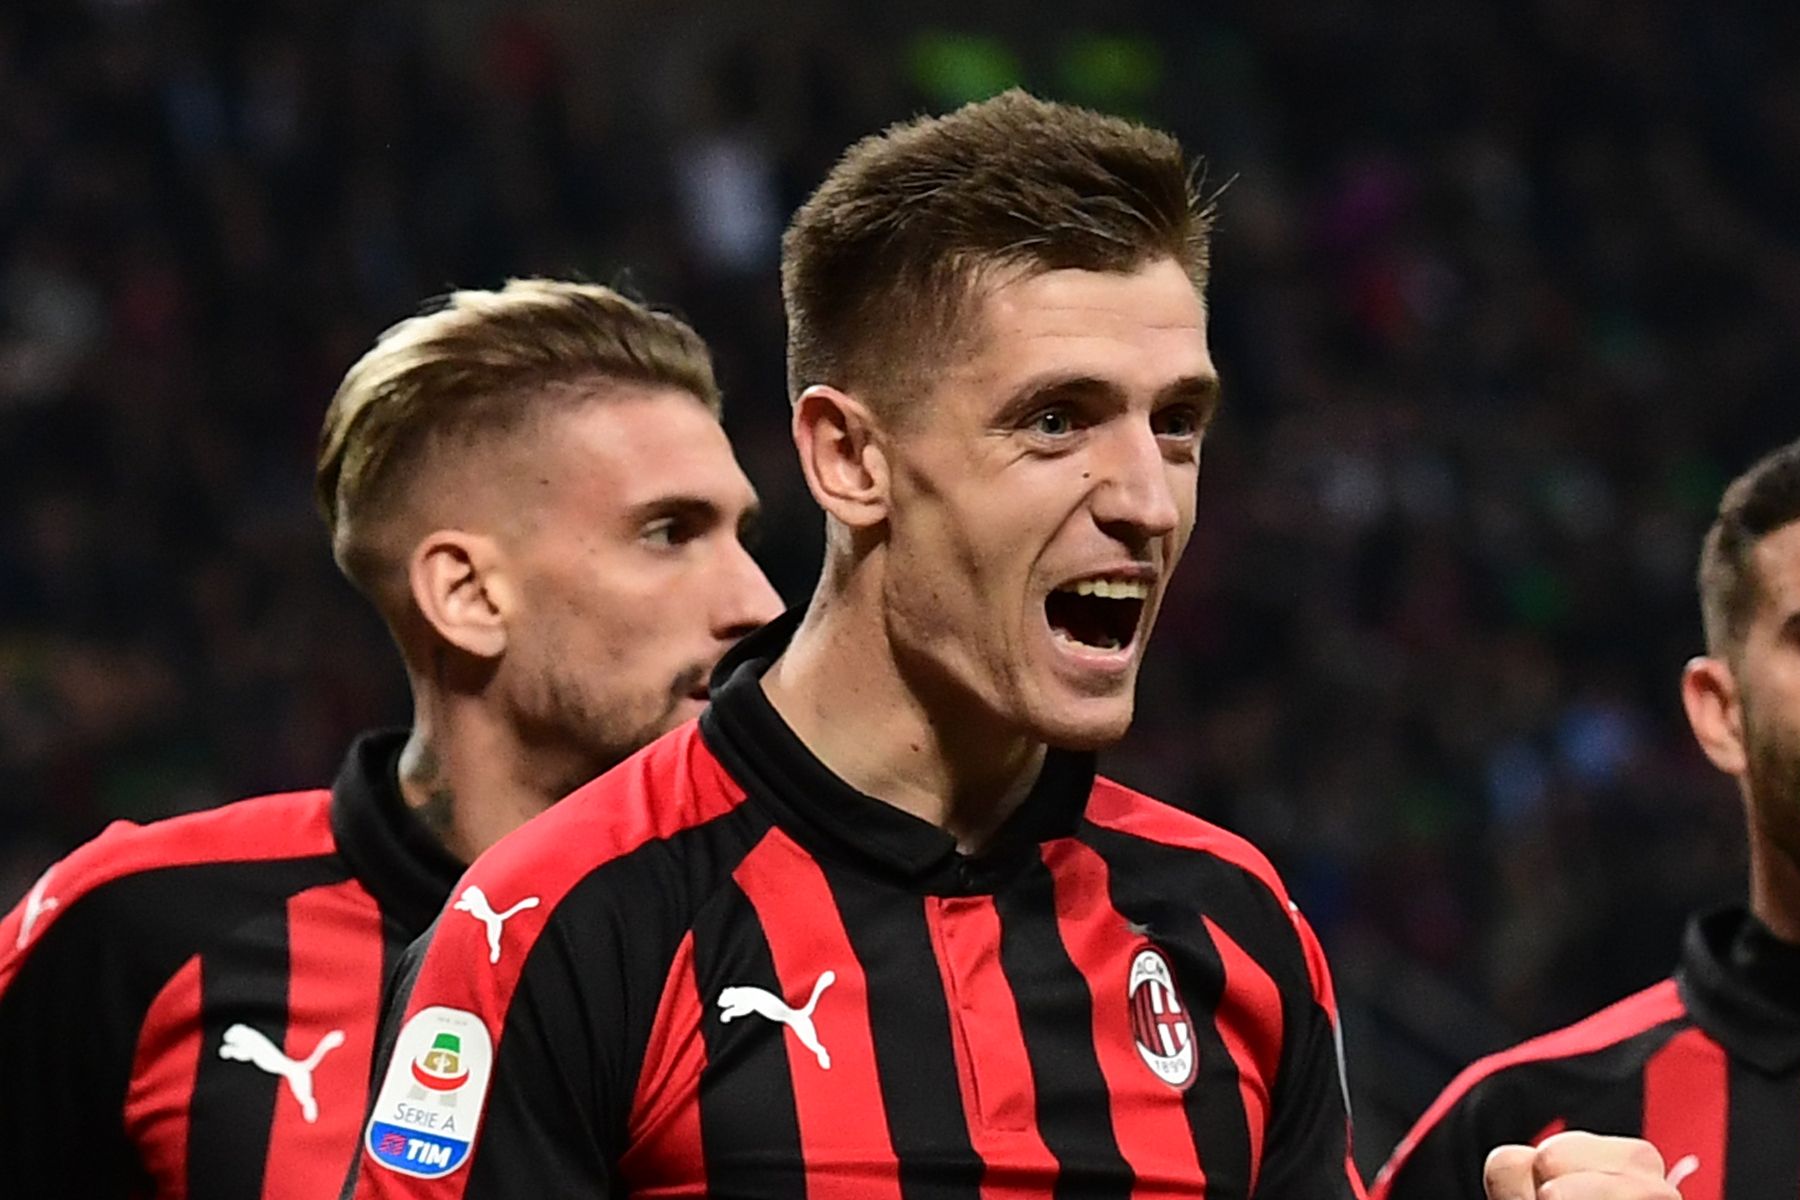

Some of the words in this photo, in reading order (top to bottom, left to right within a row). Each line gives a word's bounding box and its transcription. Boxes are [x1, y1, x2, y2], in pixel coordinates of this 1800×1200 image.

[393, 1103, 439, 1128] SERIE
[441, 1113, 456, 1132] A
[406, 1137, 453, 1169] TIM
